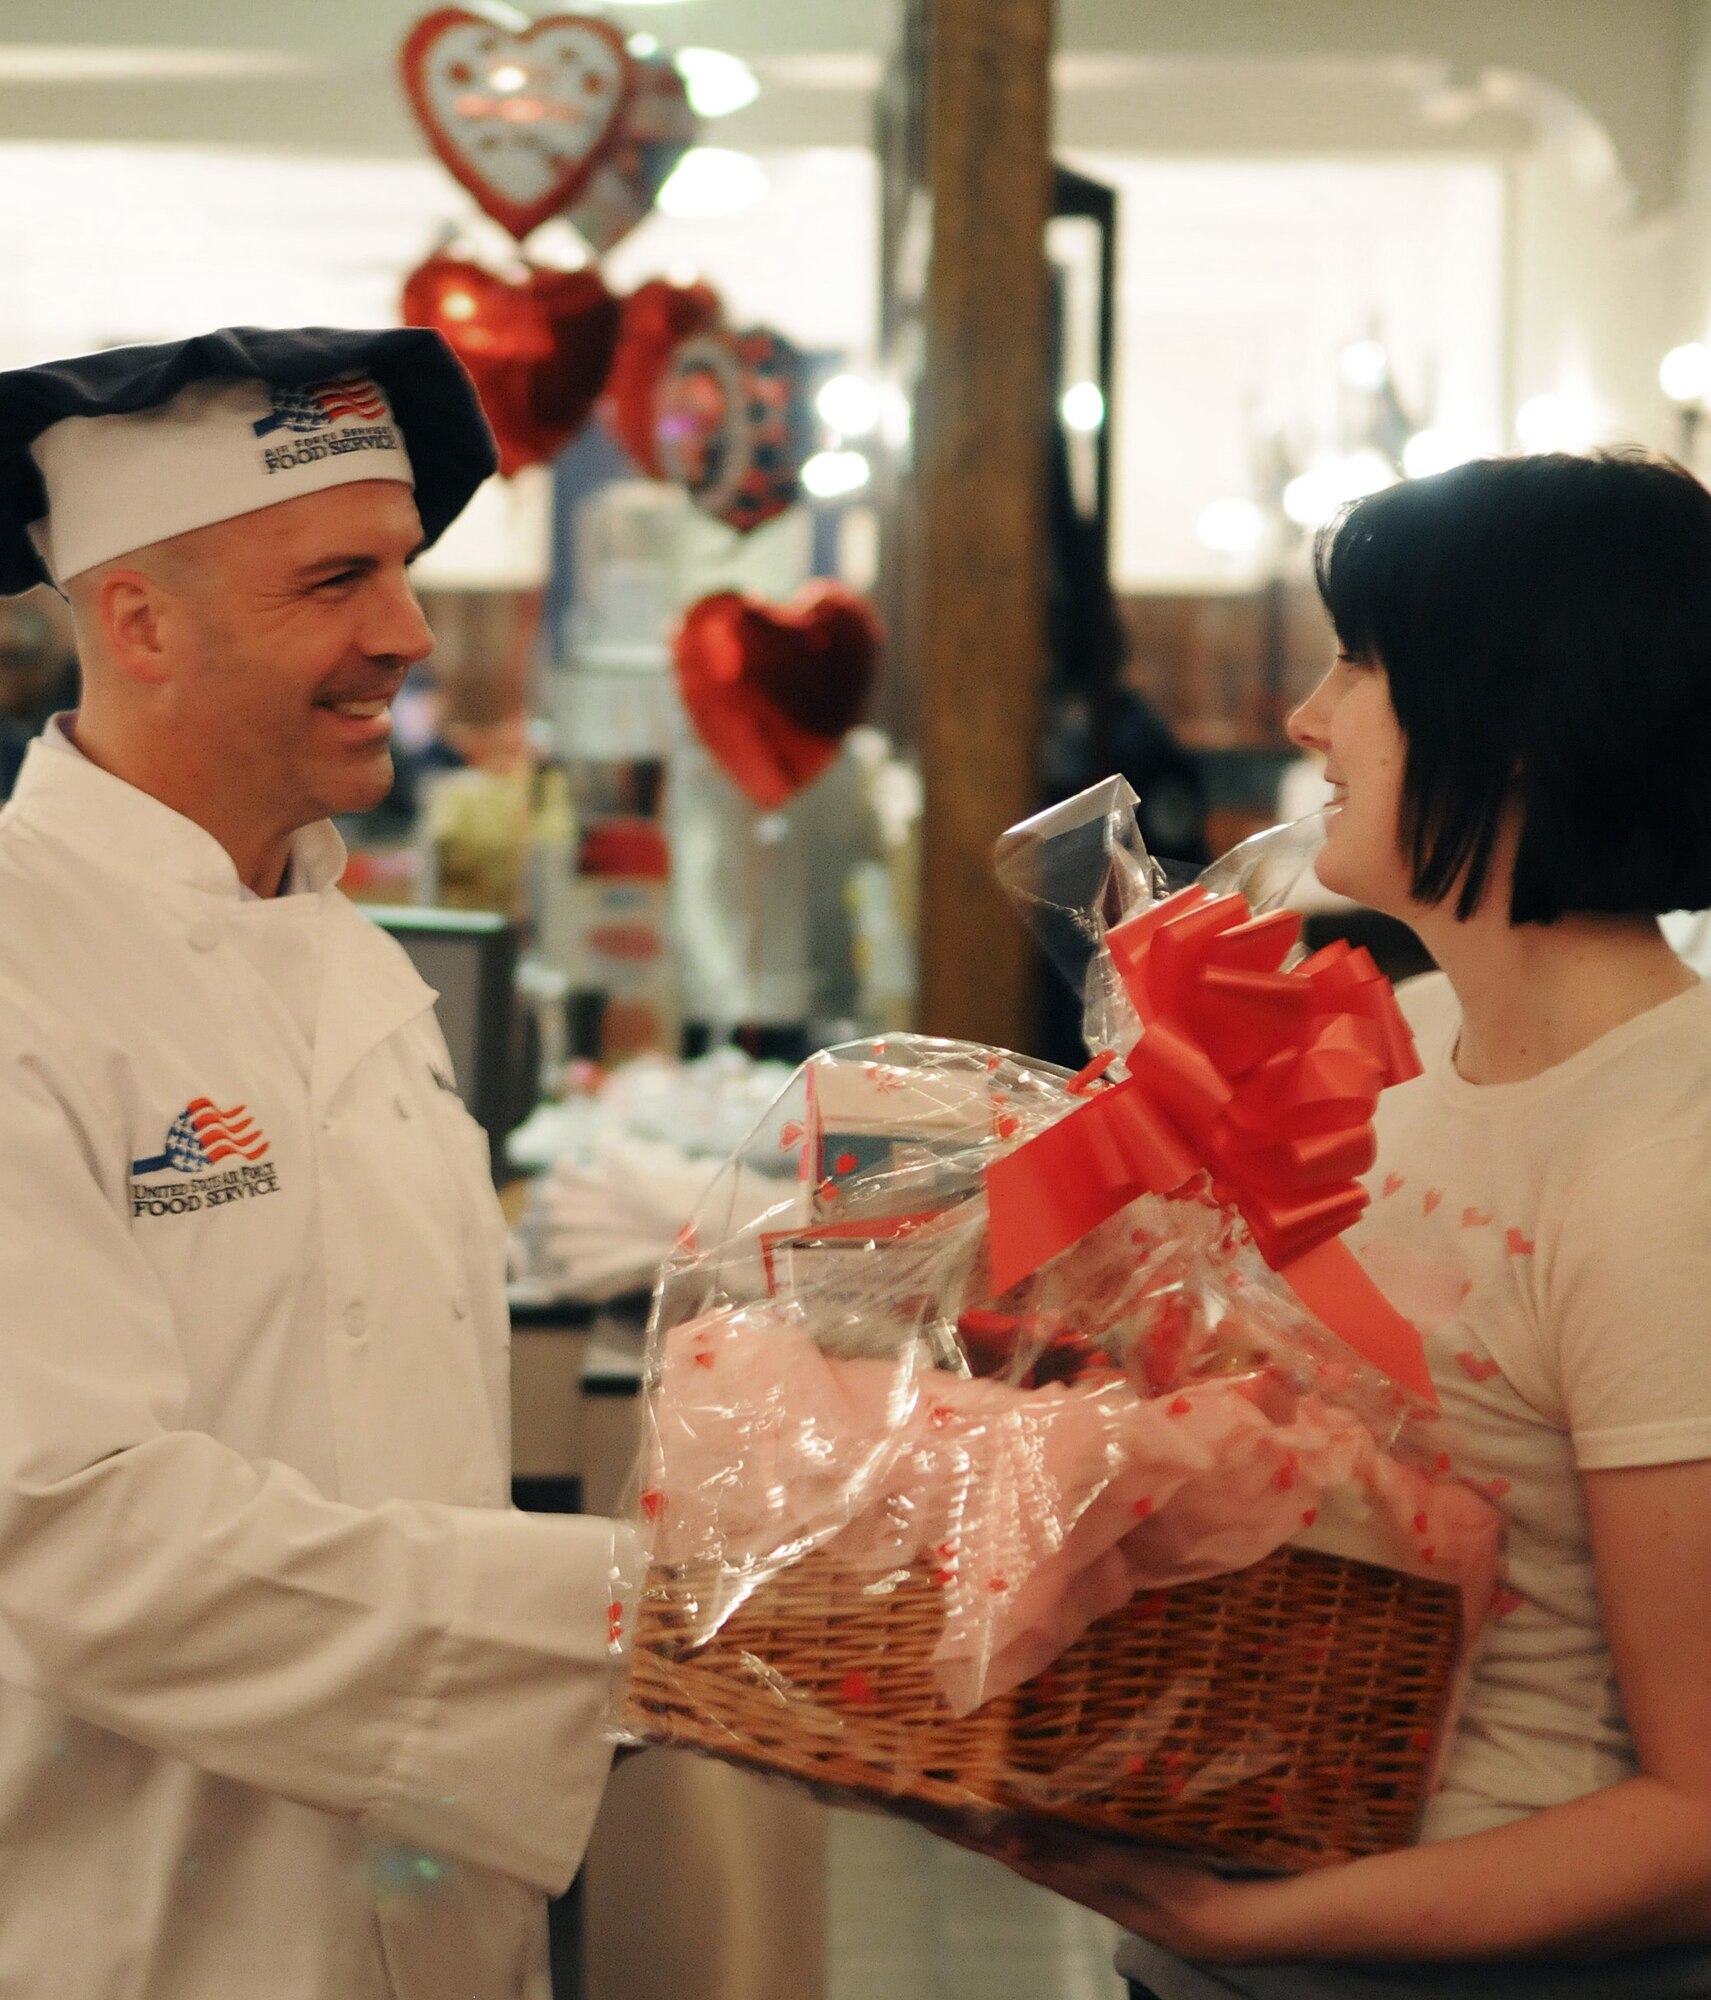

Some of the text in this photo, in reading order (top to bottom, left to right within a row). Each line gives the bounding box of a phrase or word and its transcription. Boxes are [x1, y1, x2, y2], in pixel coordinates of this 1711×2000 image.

[264, 444, 289, 458] AIR
[294, 432, 338, 448] FORCE
[265, 434, 397, 474] FOOD SERVICE
[132, 1183, 188, 1199] UNITED
[222, 1171, 240, 1185] AIR
[240, 1162, 276, 1180] FORCE
[134, 1175, 281, 1217] FOOD SERVICE
